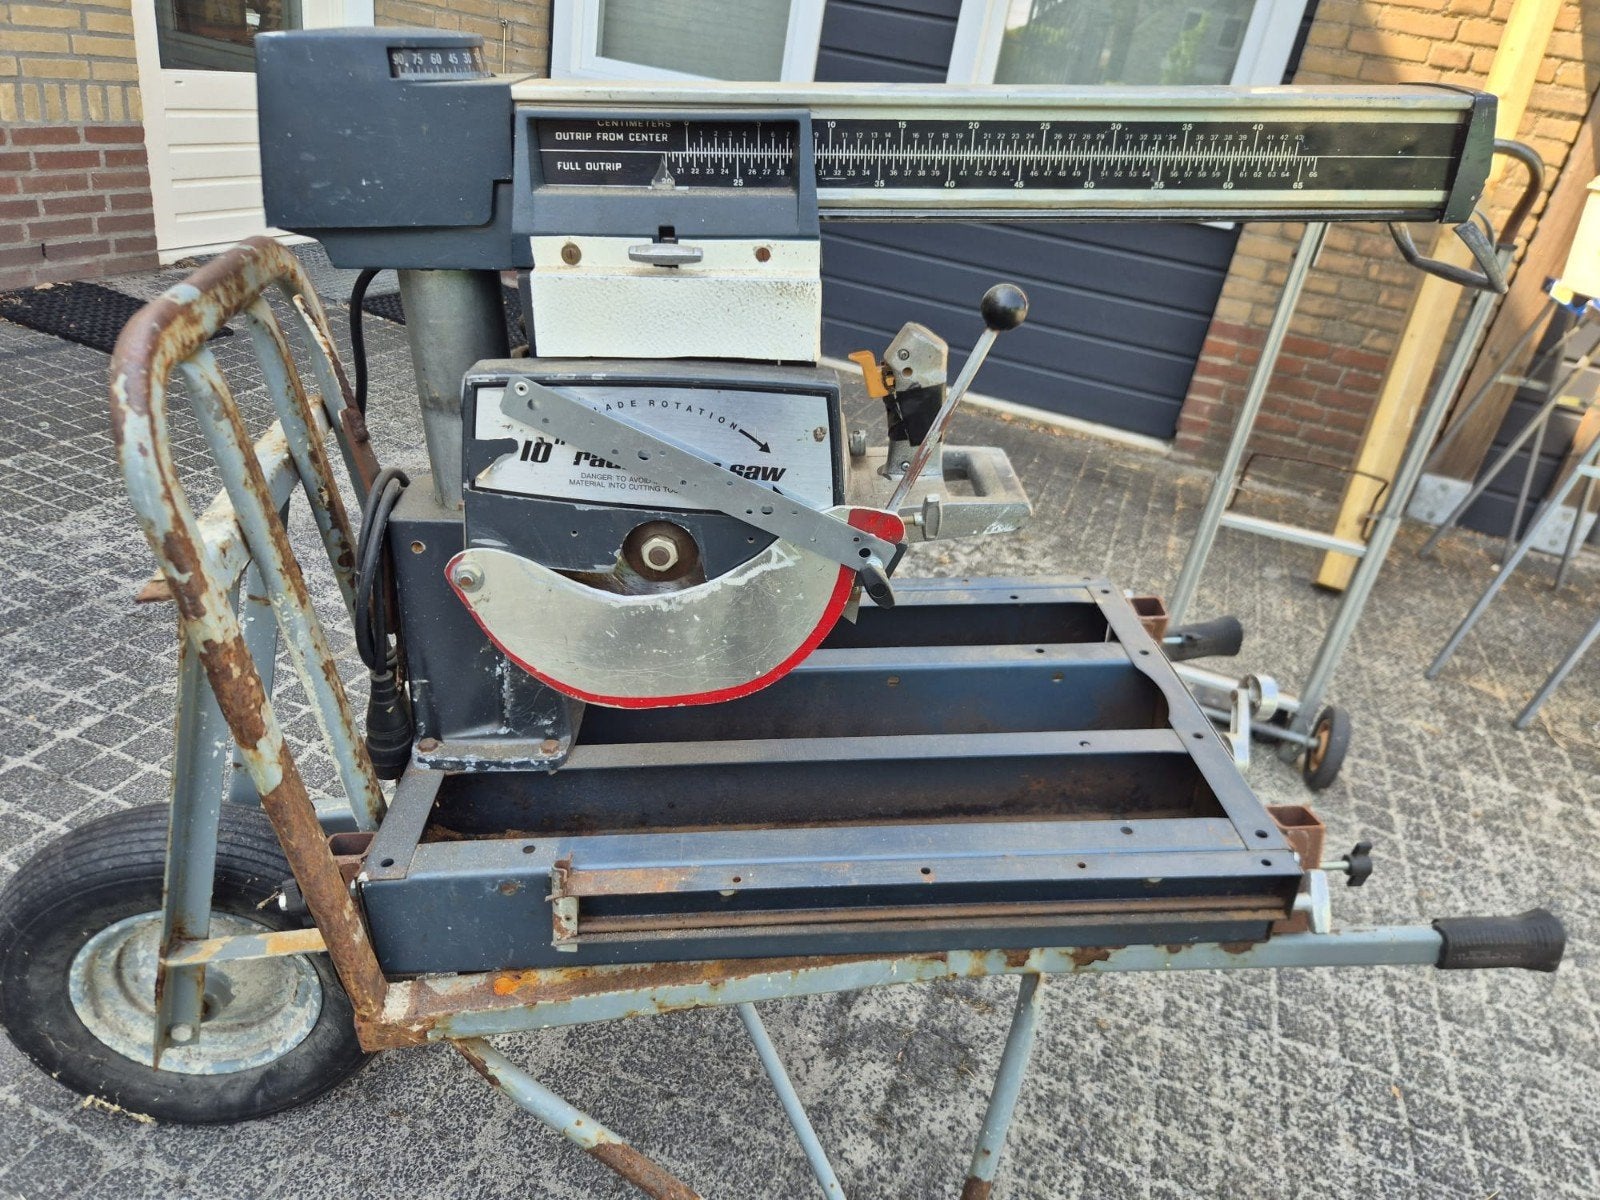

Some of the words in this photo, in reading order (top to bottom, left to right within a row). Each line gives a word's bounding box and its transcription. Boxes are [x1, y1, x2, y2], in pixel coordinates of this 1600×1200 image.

[393, 53, 404, 65] 90
[412, 53, 424, 65] 75
[430, 53, 442, 65] 60
[448, 53, 459, 65] 45
[462, 53, 472, 64] 30
[597, 120, 672, 128] CENTIMETERS
[968, 122, 980, 130] 20
[555, 131, 592, 141] OUTRIP
[596, 132, 624, 141] FROM
[629, 133, 668, 142] CENTER
[557, 162, 581, 171] FULL
[585, 162, 622, 171] OUTRIP
[593, 400, 637, 412] ADE
[649, 399, 738, 430] ROTATION
[581, 473, 612, 481] DANGER
[729, 464, 786, 482] saw
[569, 479, 605, 488] MATERIAL
[629, 484, 661, 492] CUTTING
